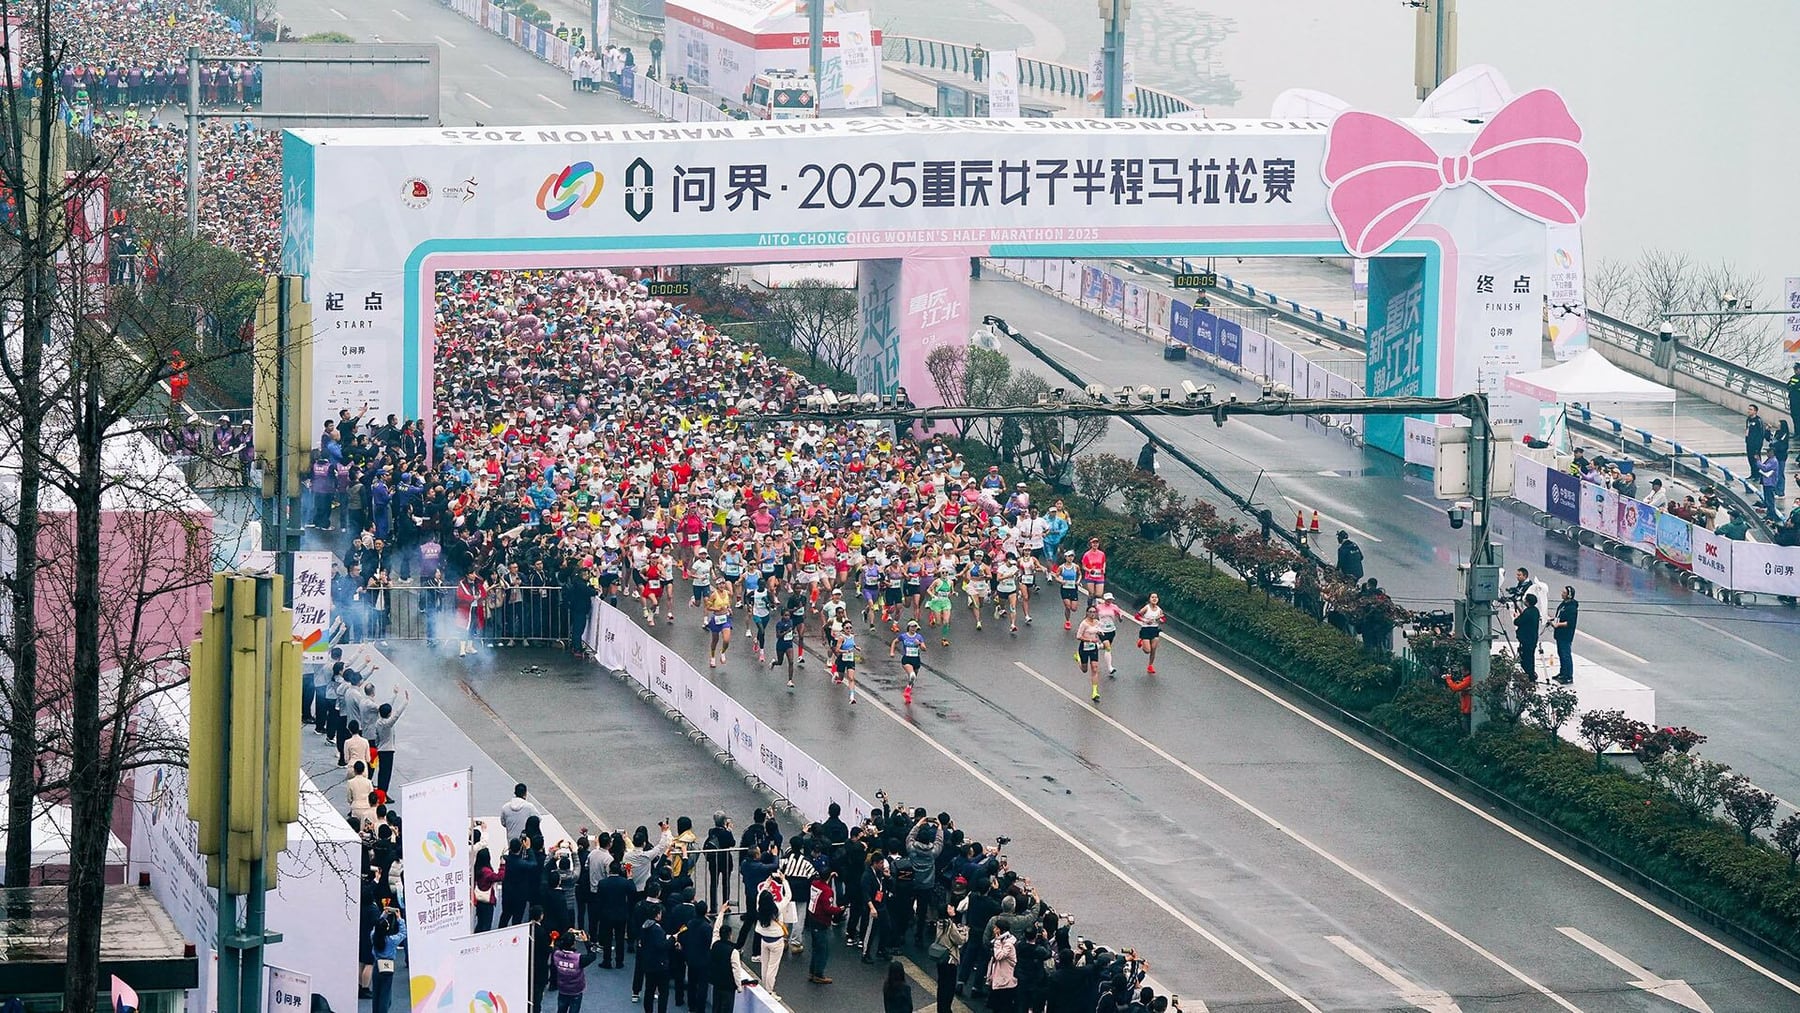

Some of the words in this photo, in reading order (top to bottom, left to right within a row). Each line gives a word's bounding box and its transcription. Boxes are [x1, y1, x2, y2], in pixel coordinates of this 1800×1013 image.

[441, 130, 526, 142] 2025
[537, 127, 734, 143] MARATHON
[748, 122, 836, 138] HALF
[885, 230, 949, 243] WOMEN'S
[953, 229, 987, 242] HALF
[990, 228, 1064, 241] MARATHON
[1068, 228, 1099, 240] 2025
[1177, 276, 1215, 286] 0:00:05
[1477, 275, 1530, 293] 终点
[651, 284, 689, 295] 0:00:05
[325, 291, 383, 311] 起点
[908, 287, 949, 316] 重庆
[1485, 303, 1520, 311] FINISH
[920, 300, 962, 330] 江北
[1384, 281, 1423, 342] 重庆
[336, 320, 373, 329] START
[1497, 328, 1513, 337] 问界
[349, 346, 366, 355] 问界
[1385, 329, 1423, 391] 江北
[1774, 564, 1795, 577] 问界
[301, 580, 326, 597] 好美
[301, 609, 326, 625] 江北
[284, 993, 302, 1008] 问界
